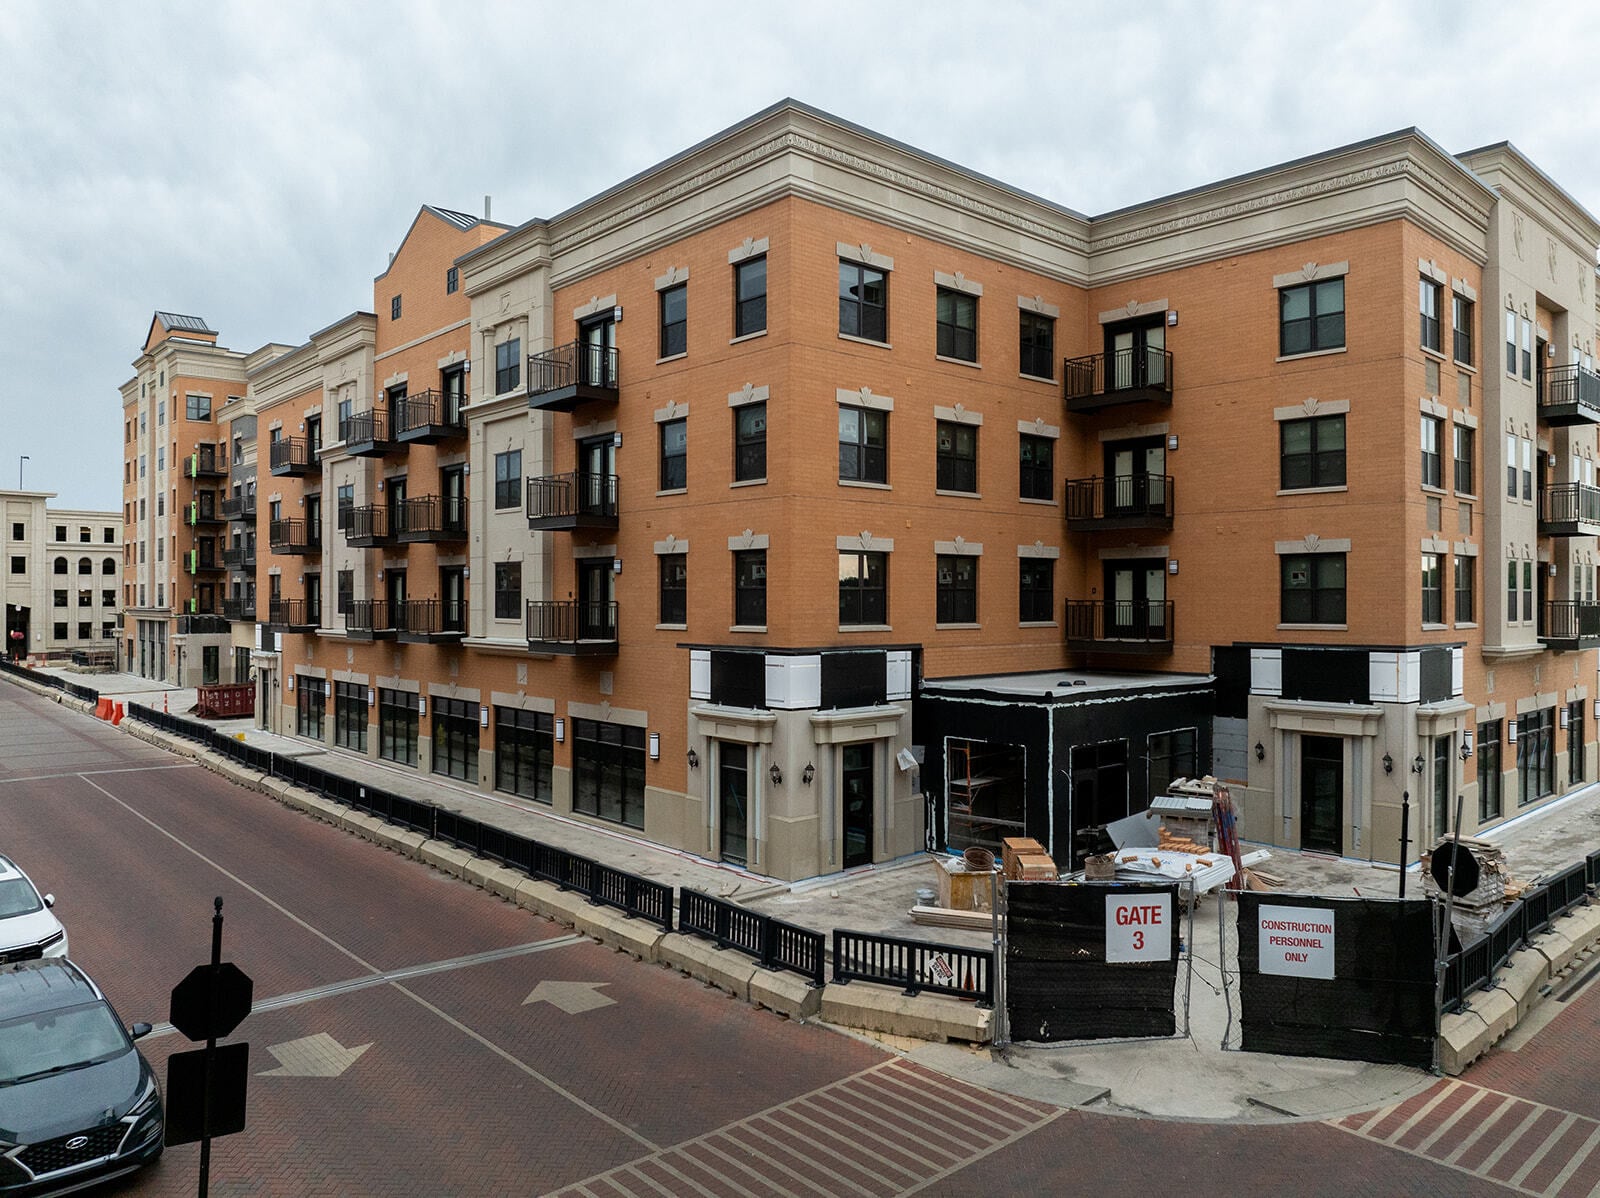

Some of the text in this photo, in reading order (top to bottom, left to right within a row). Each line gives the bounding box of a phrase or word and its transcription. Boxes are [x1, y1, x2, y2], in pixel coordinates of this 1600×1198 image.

[1116, 905, 1162, 926] GATE
[1261, 920, 1332, 934] CONSTRUCTION
[1132, 930, 1145, 950] 3
[1269, 936, 1324, 949] PERSONNEL
[1284, 952, 1308, 963] ONLY
